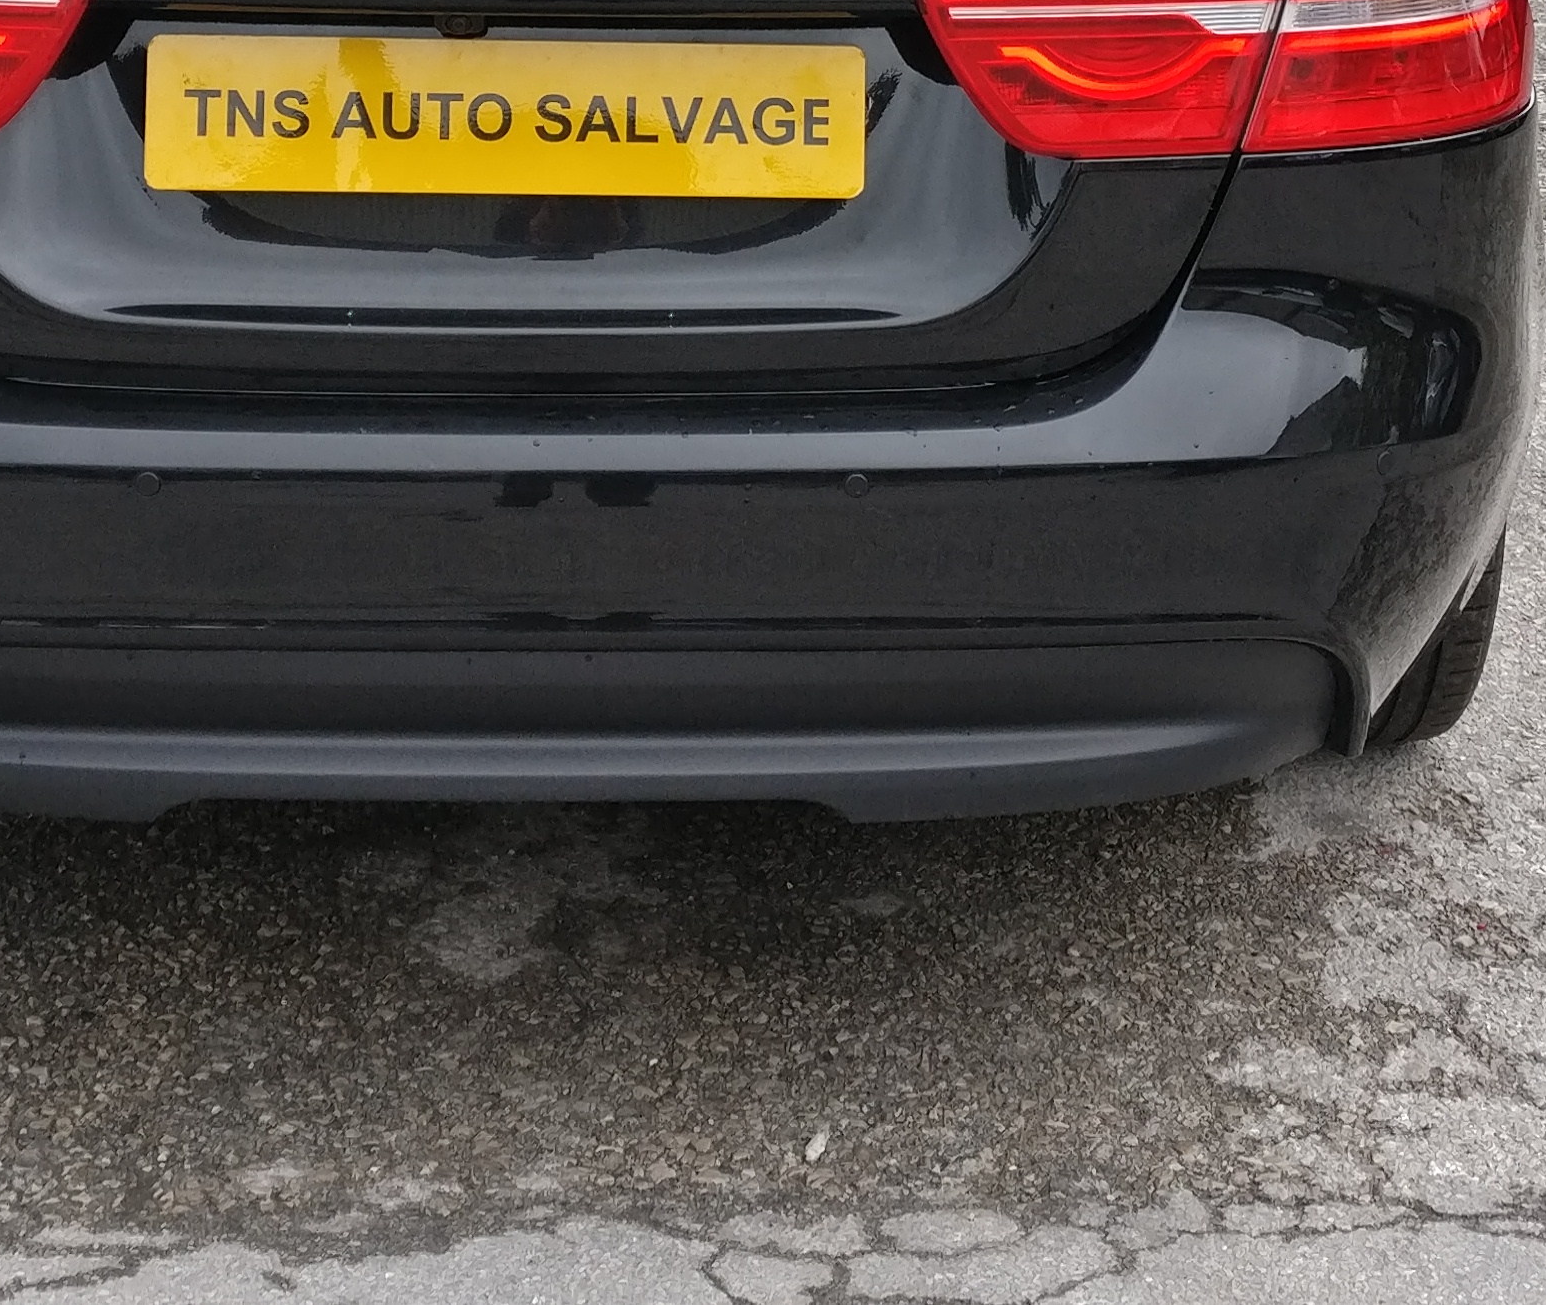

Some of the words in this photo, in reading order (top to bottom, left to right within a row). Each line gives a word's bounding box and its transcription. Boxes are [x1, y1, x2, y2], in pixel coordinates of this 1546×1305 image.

[184, 88, 310, 139] TNS
[331, 90, 512, 142] AUTO
[534, 95, 831, 146] SALVAGE
